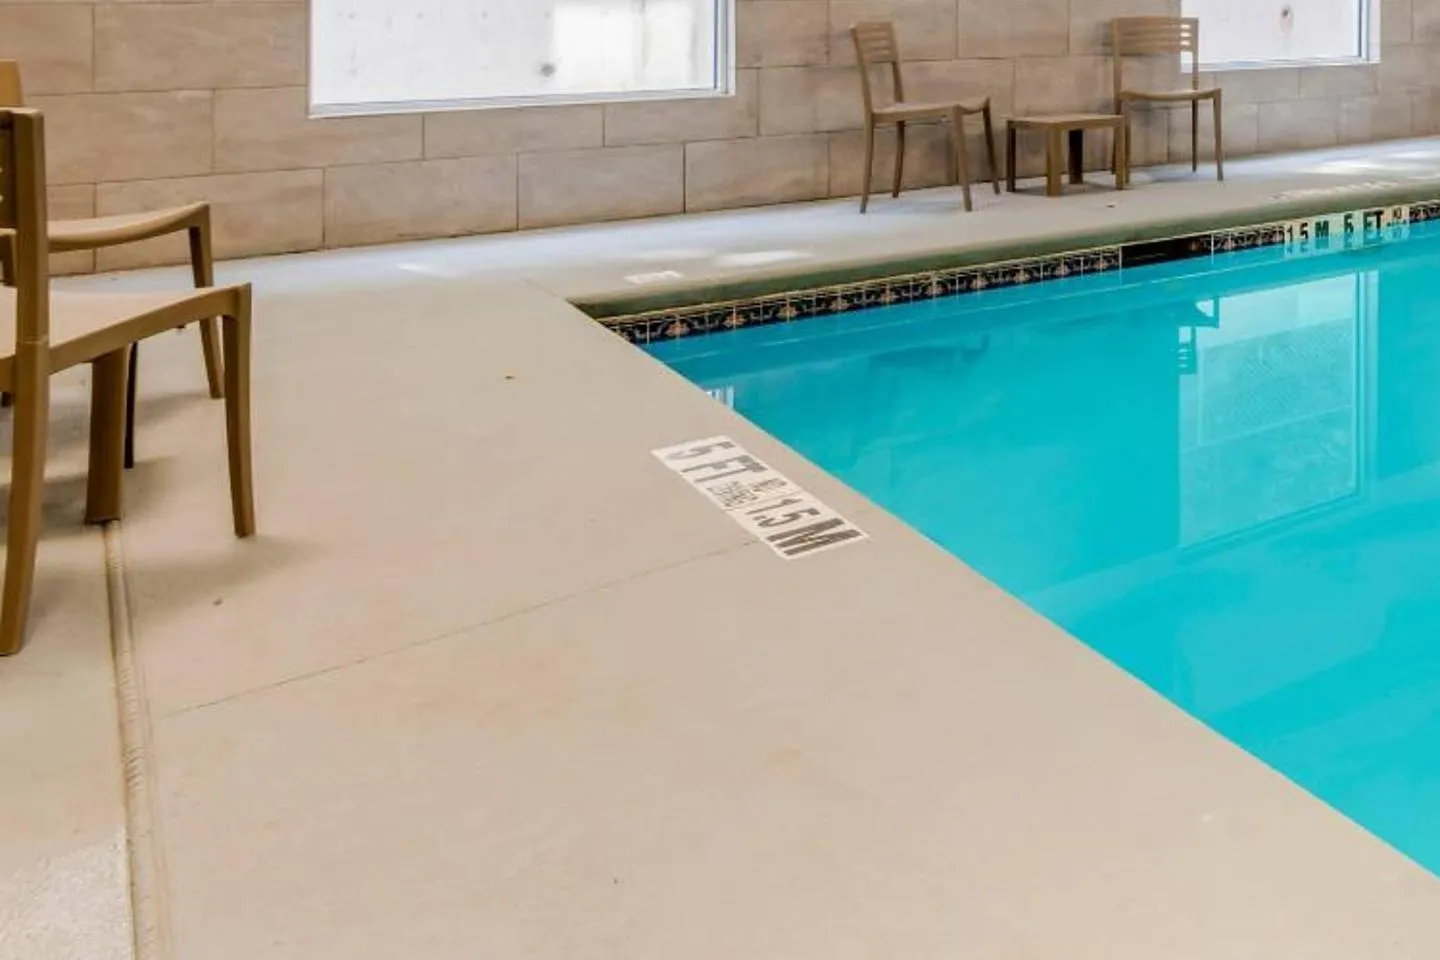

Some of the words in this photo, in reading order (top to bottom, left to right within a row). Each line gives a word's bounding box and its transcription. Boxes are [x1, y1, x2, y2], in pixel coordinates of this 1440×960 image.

[1315, 221, 1329, 239] M
[1363, 210, 1384, 231] FT
[665, 441, 735, 460] 5
[680, 454, 769, 483] FT
[765, 517, 862, 557] M
